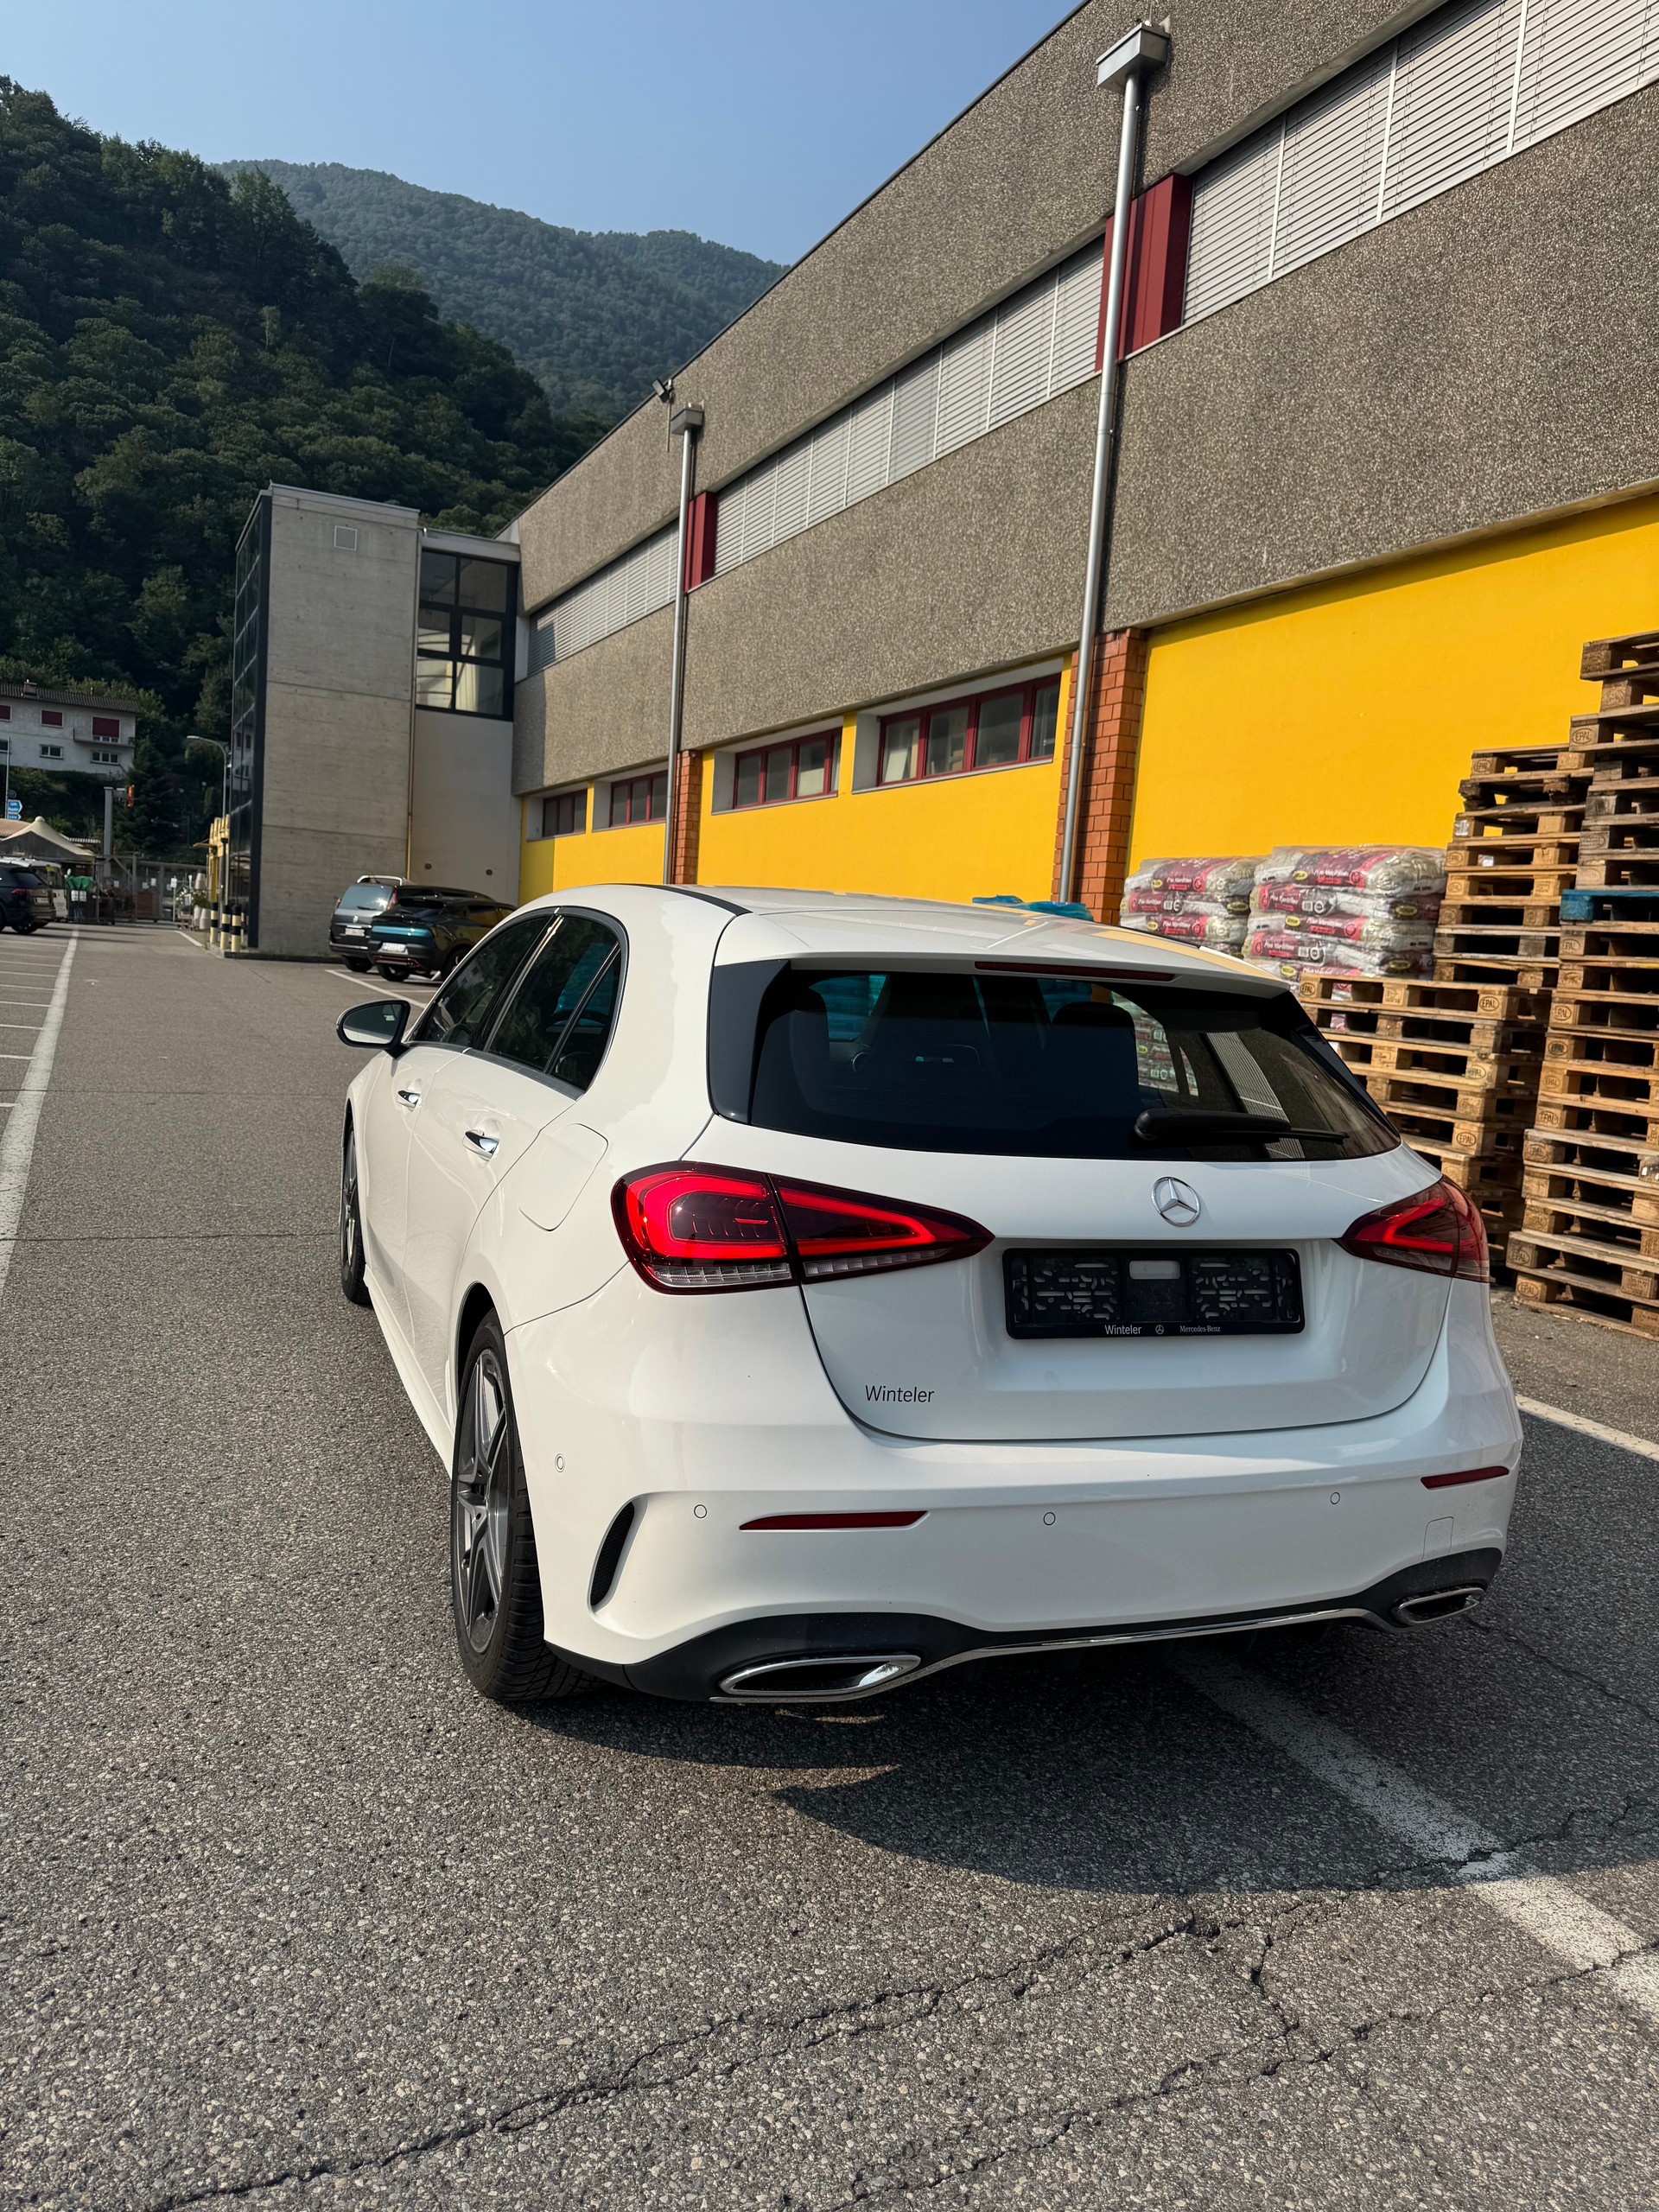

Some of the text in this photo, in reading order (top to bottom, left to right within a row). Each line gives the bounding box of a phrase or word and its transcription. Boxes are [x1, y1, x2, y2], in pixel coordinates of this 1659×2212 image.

[1481, 999, 1497, 1008] EPAL
[1459, 1134, 1472, 1144] EPAL
[1511, 1252, 1527, 1262] EPAL
[1521, 1282, 1535, 1294] EPAL
[1104, 1325, 1142, 1335] Winteler
[865, 1384, 935, 1402] Winteler
